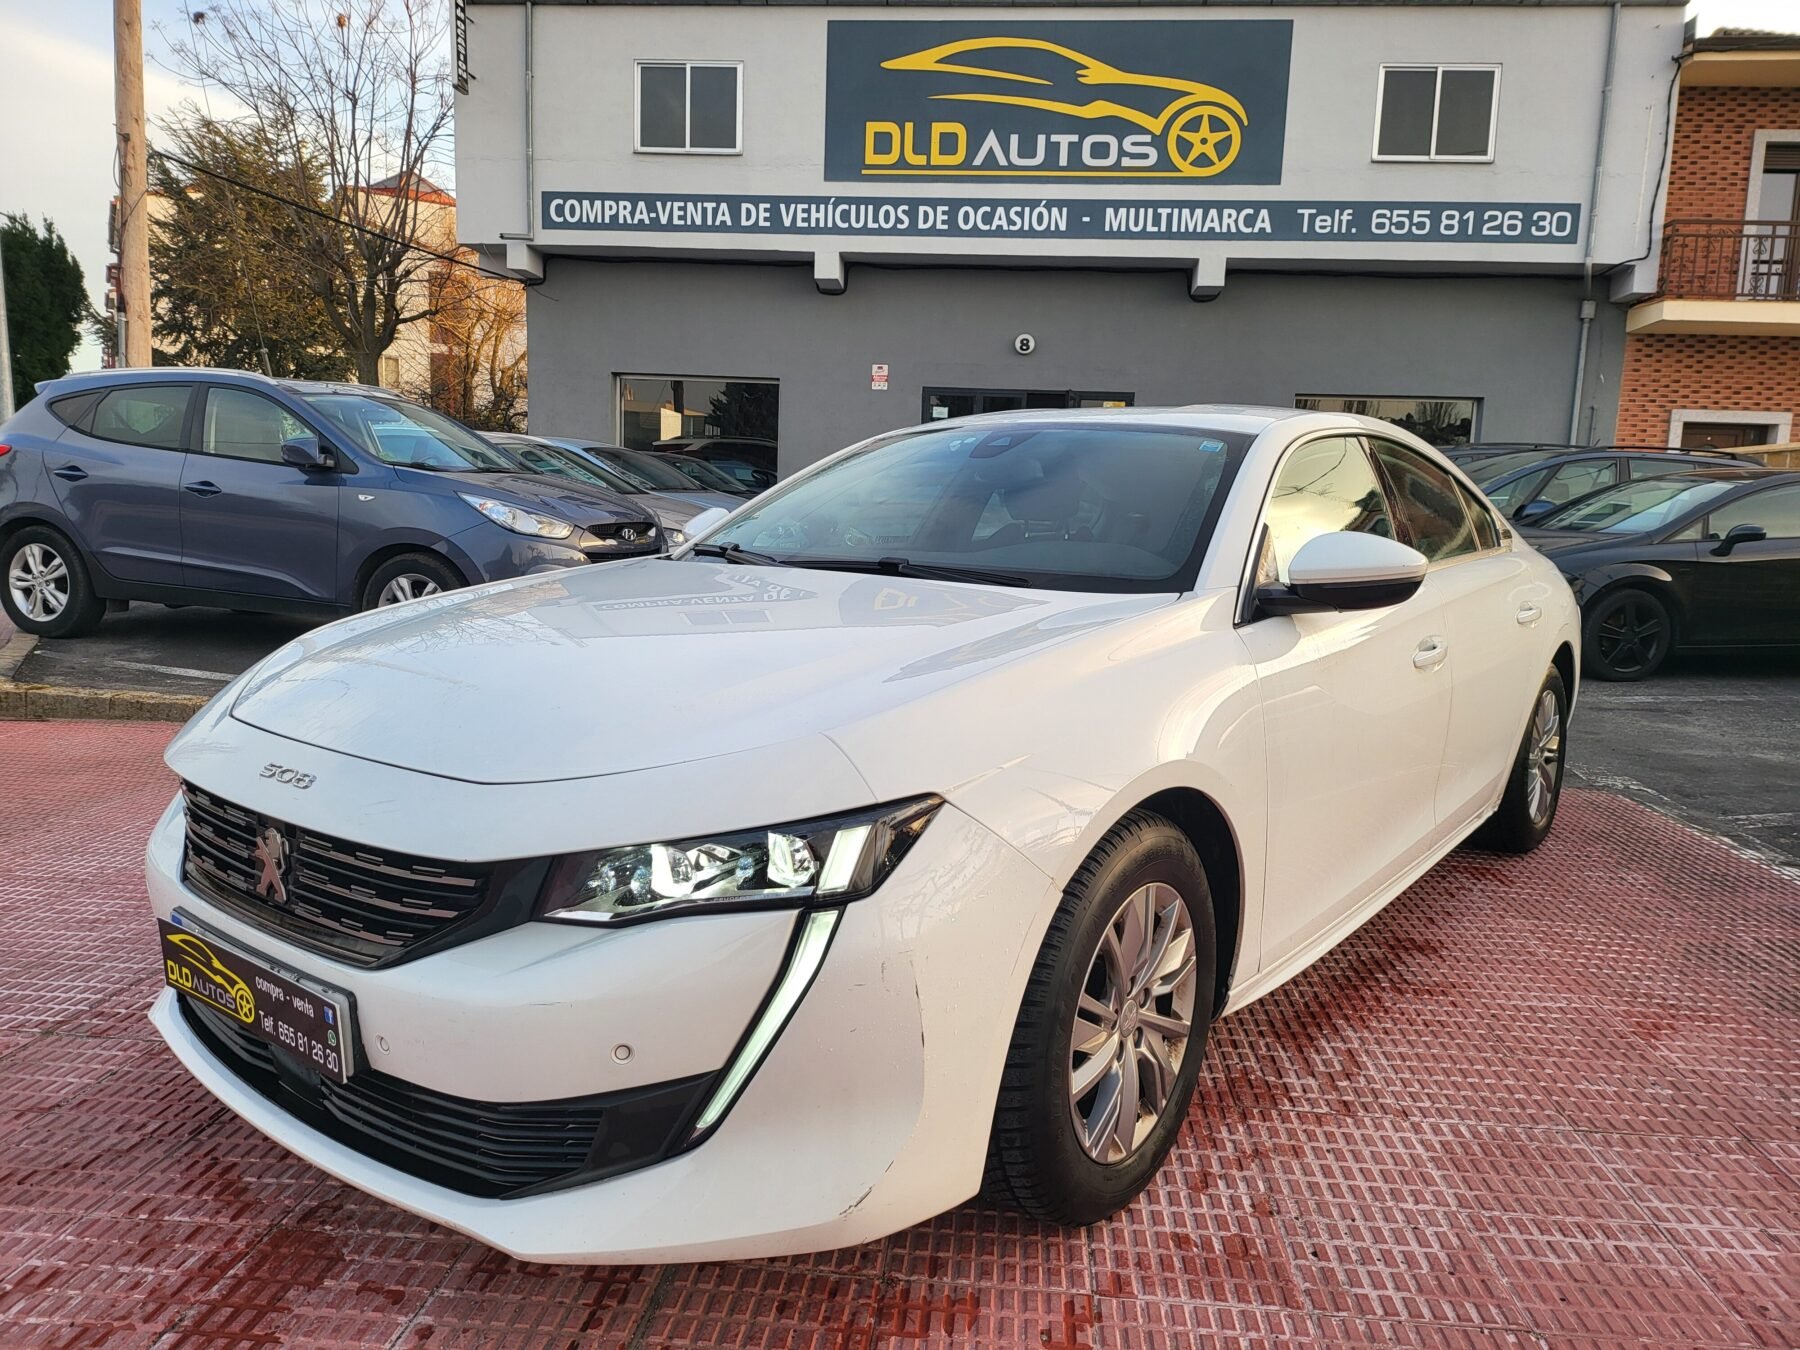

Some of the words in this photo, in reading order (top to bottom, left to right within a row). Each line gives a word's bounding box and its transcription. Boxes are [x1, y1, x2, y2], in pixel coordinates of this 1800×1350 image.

[864, 121, 967, 165] DLD
[972, 129, 1159, 167] AUTOS
[549, 199, 732, 226] COMPRA-VENTA
[740, 203, 771, 227] DE
[780, 197, 909, 228] VEHÍCULOS
[917, 205, 949, 230] DE
[957, 200, 1068, 231] OCASIÓN
[1104, 207, 1272, 233] MULTIMARCA
[1296, 209, 1357, 233] Telf.
[1370, 209, 1431, 235] 655
[1530, 211, 1573, 237] 30
[1020, 338, 1030, 351] 8
[259, 762, 318, 790] 508
[167, 959, 192, 988] DLD
[192, 974, 236, 1010] AUTOS
[255, 976, 284, 1002] compra
[291, 995, 315, 1018] venta
[258, 1010, 276, 1036] Telf.
[278, 1021, 296, 1047] 655
[297, 1032, 309, 1055] 81
[311, 1040, 325, 1064] 26
[325, 1049, 339, 1072] 30
